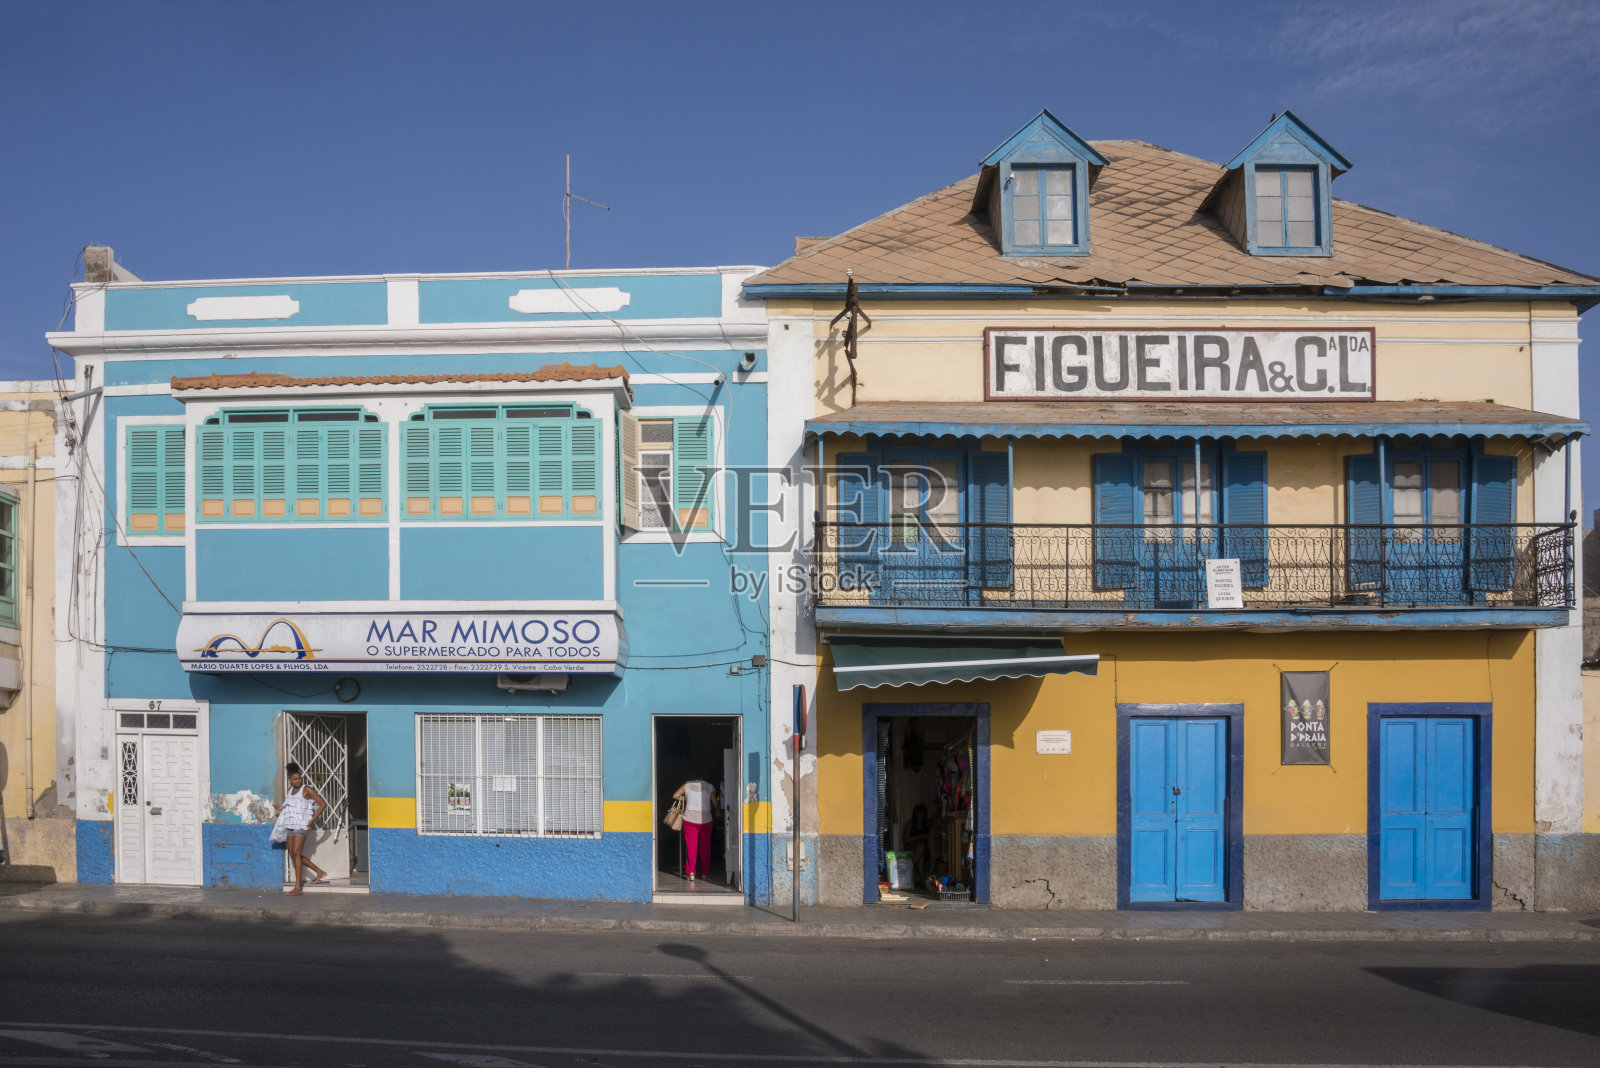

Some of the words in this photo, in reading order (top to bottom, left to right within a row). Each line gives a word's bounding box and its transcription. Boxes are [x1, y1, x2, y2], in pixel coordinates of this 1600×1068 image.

[995, 335, 1269, 392] FIGUEIRA
[366, 619, 438, 643] MAR
[450, 619, 601, 645] MIMOSO
[366, 645, 379, 657] O
[384, 645, 501, 657] SUPERMERCADO
[506, 646, 542, 657] PARA
[547, 646, 601, 658] TODOS
[149, 700, 162, 711] 67
[1290, 721, 1325, 732] PONTA
